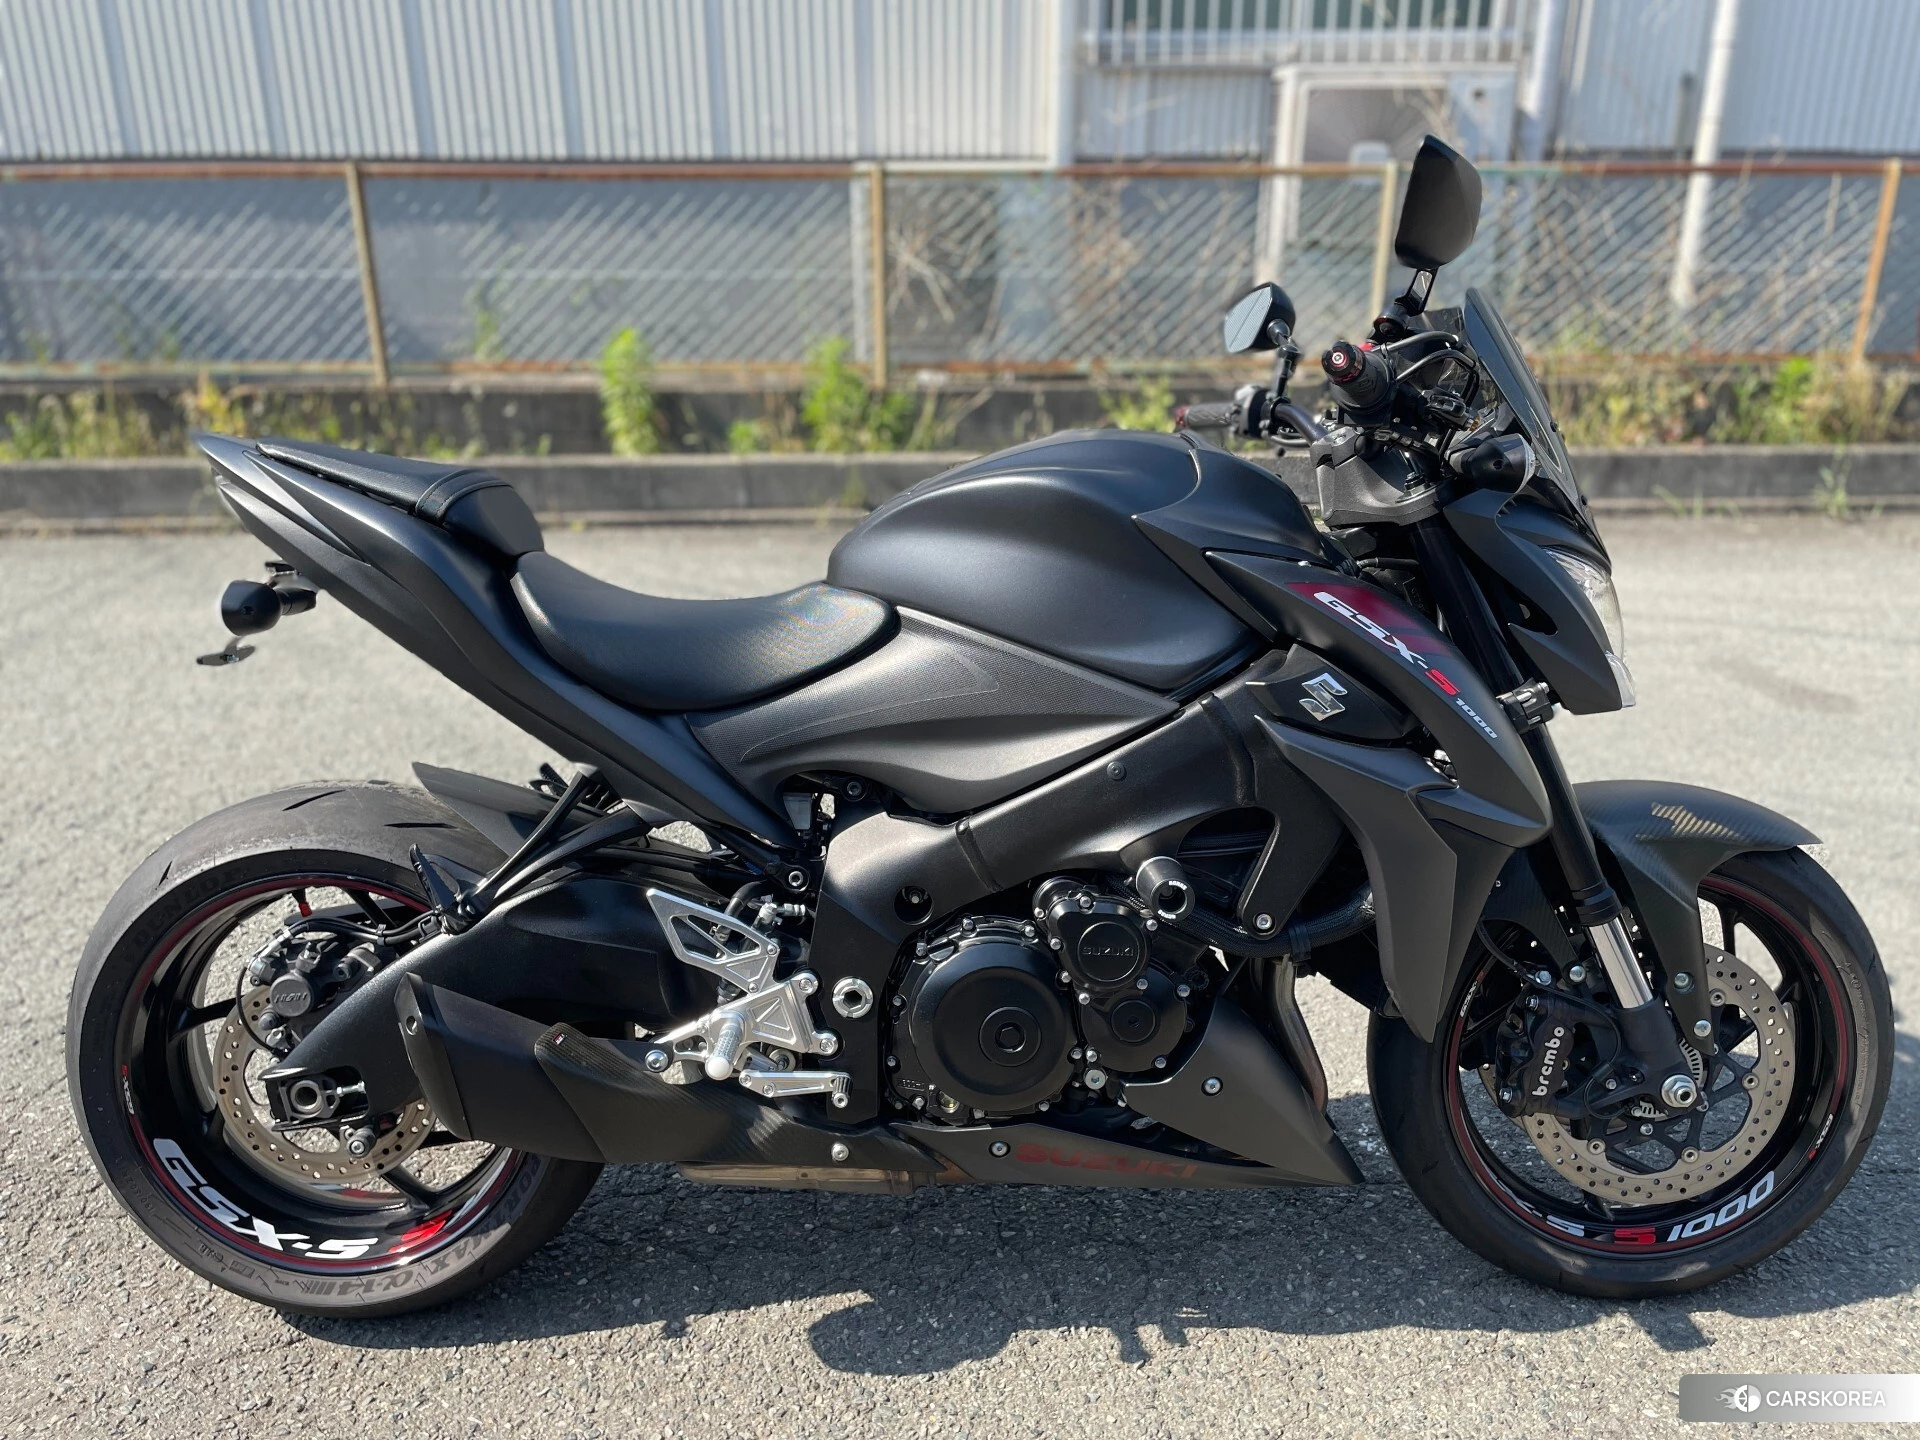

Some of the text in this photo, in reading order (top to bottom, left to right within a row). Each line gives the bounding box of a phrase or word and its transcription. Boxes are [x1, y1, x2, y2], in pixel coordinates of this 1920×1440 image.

[1313, 591, 1498, 739] GSX-S 1000
[1083, 947, 1134, 956] SUZUKI
[1531, 1026, 1565, 1096] brembo
[1015, 1142, 1200, 1179] SUZUKI
[154, 1137, 378, 1260] GSX-S
[1667, 1170, 1775, 1243] 1000
